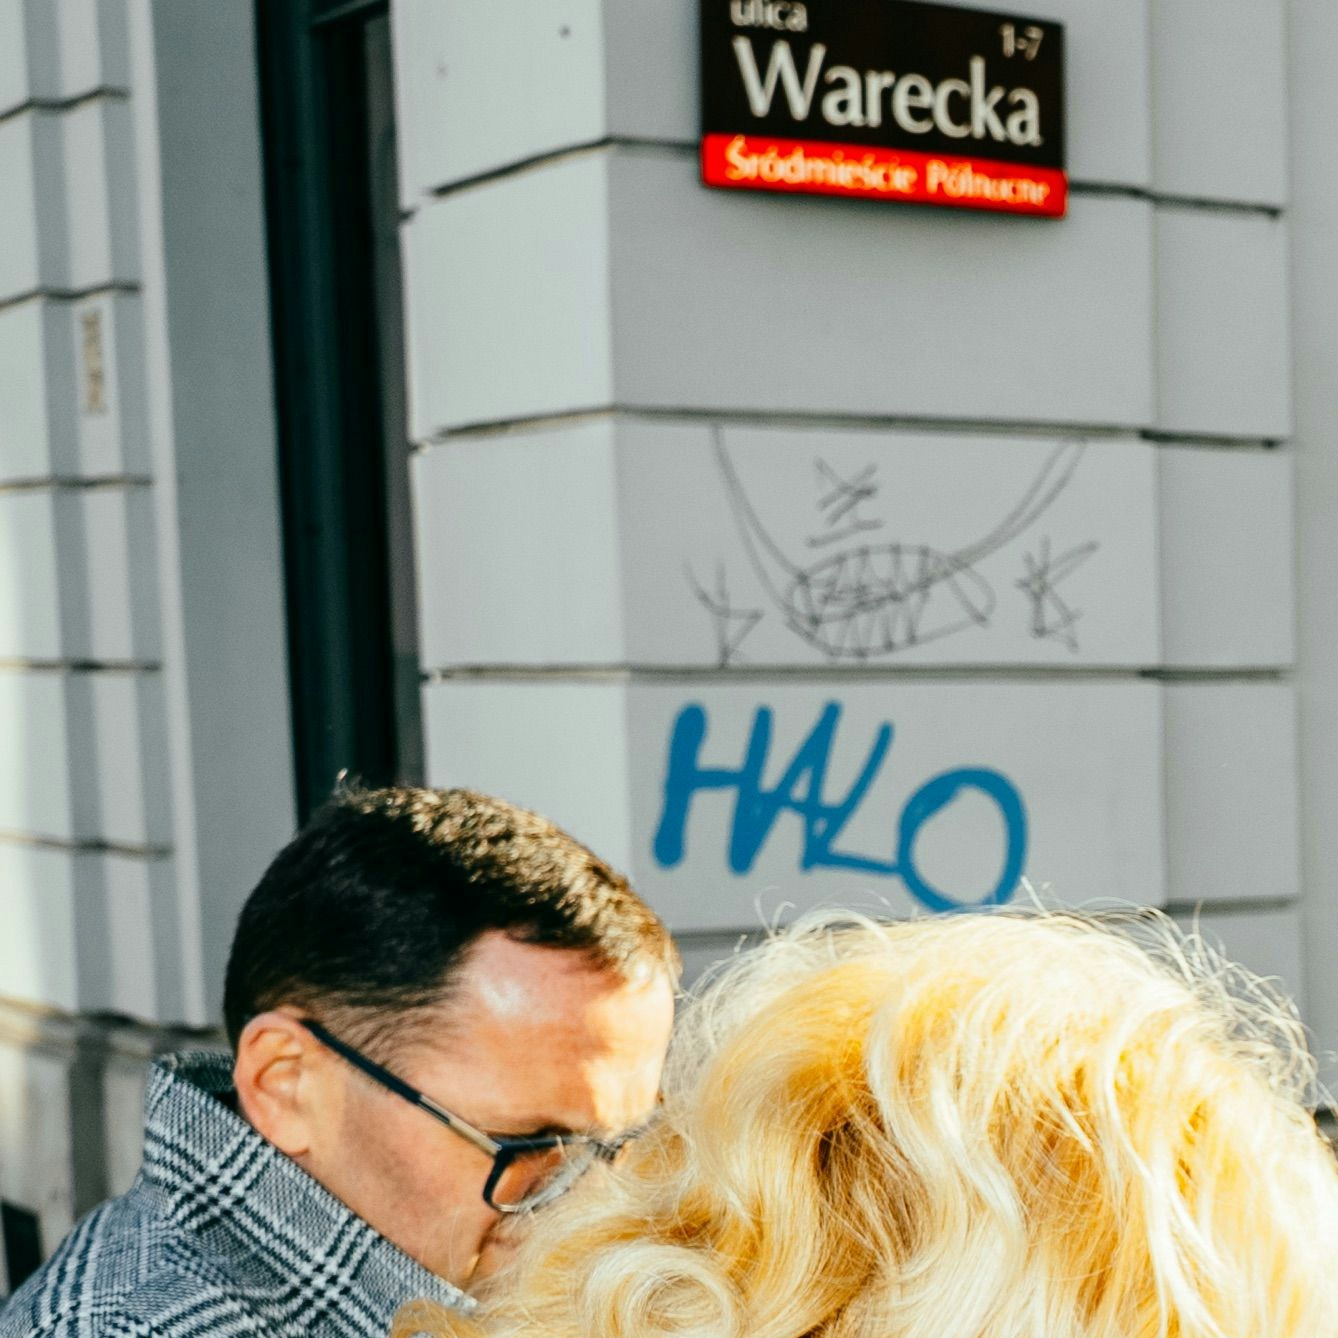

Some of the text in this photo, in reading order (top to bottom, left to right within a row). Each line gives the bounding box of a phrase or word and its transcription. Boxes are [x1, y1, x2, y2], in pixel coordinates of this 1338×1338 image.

[730, 0, 809, 31] ulica
[999, 22, 1044, 60] 1-7
[732, 34, 1044, 146] Warecka
[724, 134, 1051, 206] Śródmieście Północne
[652, 700, 1028, 913] HALO
